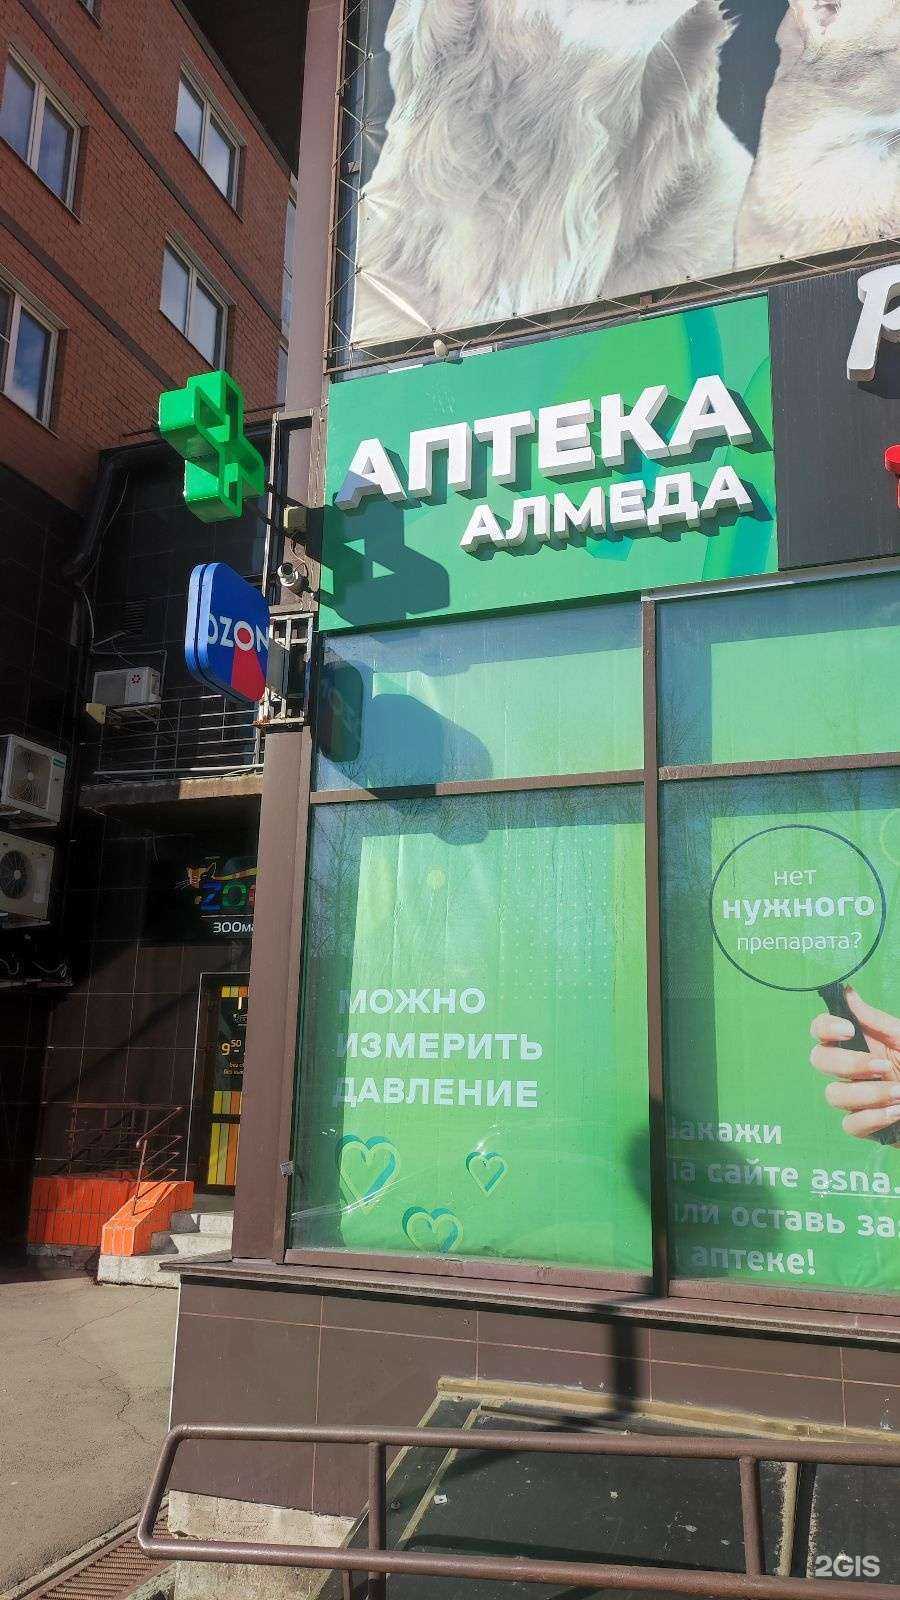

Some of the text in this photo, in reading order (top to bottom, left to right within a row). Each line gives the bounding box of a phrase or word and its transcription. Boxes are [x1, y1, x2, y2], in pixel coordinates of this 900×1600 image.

[335, 374, 755, 508] АПТЕКА
[459, 465, 753, 550] АЛМЕДА
[772, 868, 818, 888] нет
[722, 894, 877, 925] нужного
[735, 930, 863, 954] препарата?
[338, 987, 486, 1015] МОЖНО
[336, 1032, 544, 1060] ИЗМЕРИТЬ
[332, 1077, 539, 1109] ДАВЛЕНИЕ
[670, 1117, 783, 1146] акажи
[672, 1160, 697, 1183] а
[707, 1158, 799, 1188] сайте
[673, 1202, 900, 1238] ли оставь за
[690, 1246, 816, 1276] аптеке!
